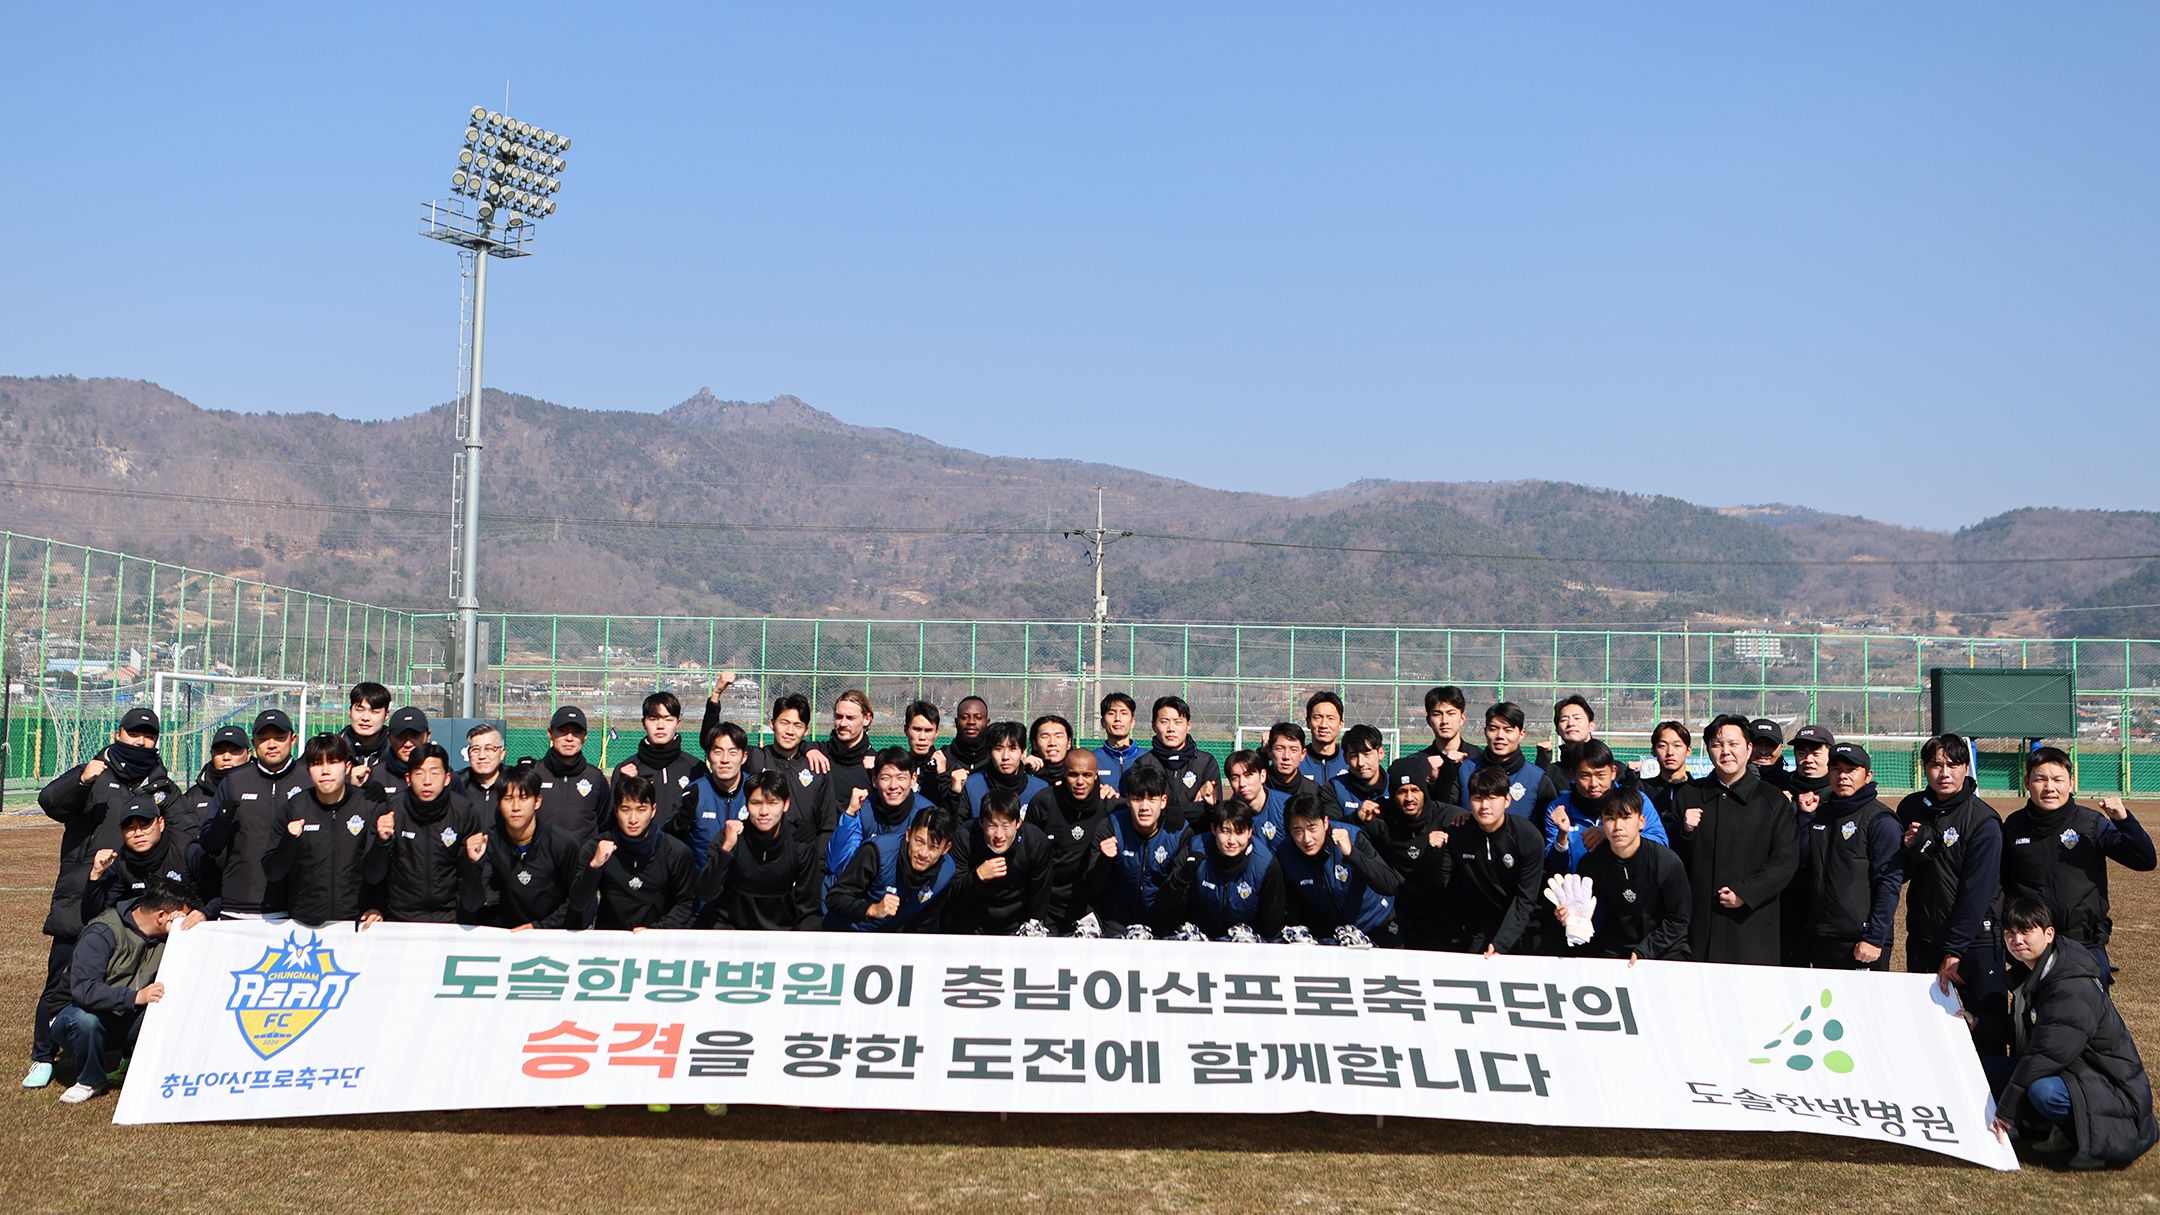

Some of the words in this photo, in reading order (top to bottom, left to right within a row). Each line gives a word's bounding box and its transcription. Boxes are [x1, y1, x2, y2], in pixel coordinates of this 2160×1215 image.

[229, 973, 351, 1009] ASAN
[268, 971, 319, 982] CHUNGNAM
[434, 955, 914, 1008] 도솔한방병원이
[941, 965, 1638, 1036] 충남아산프로축구단의
[263, 1012, 292, 1028] FC
[521, 1020, 755, 1079] 승격을
[782, 1032, 925, 1080] 향한
[946, 1037, 1161, 1085] 도전에
[1187, 1040, 1551, 1098] 함께합니다
[160, 1066, 365, 1099] 충남아산프로축구단
[1685, 1081, 1960, 1145] 도솔한방병원
